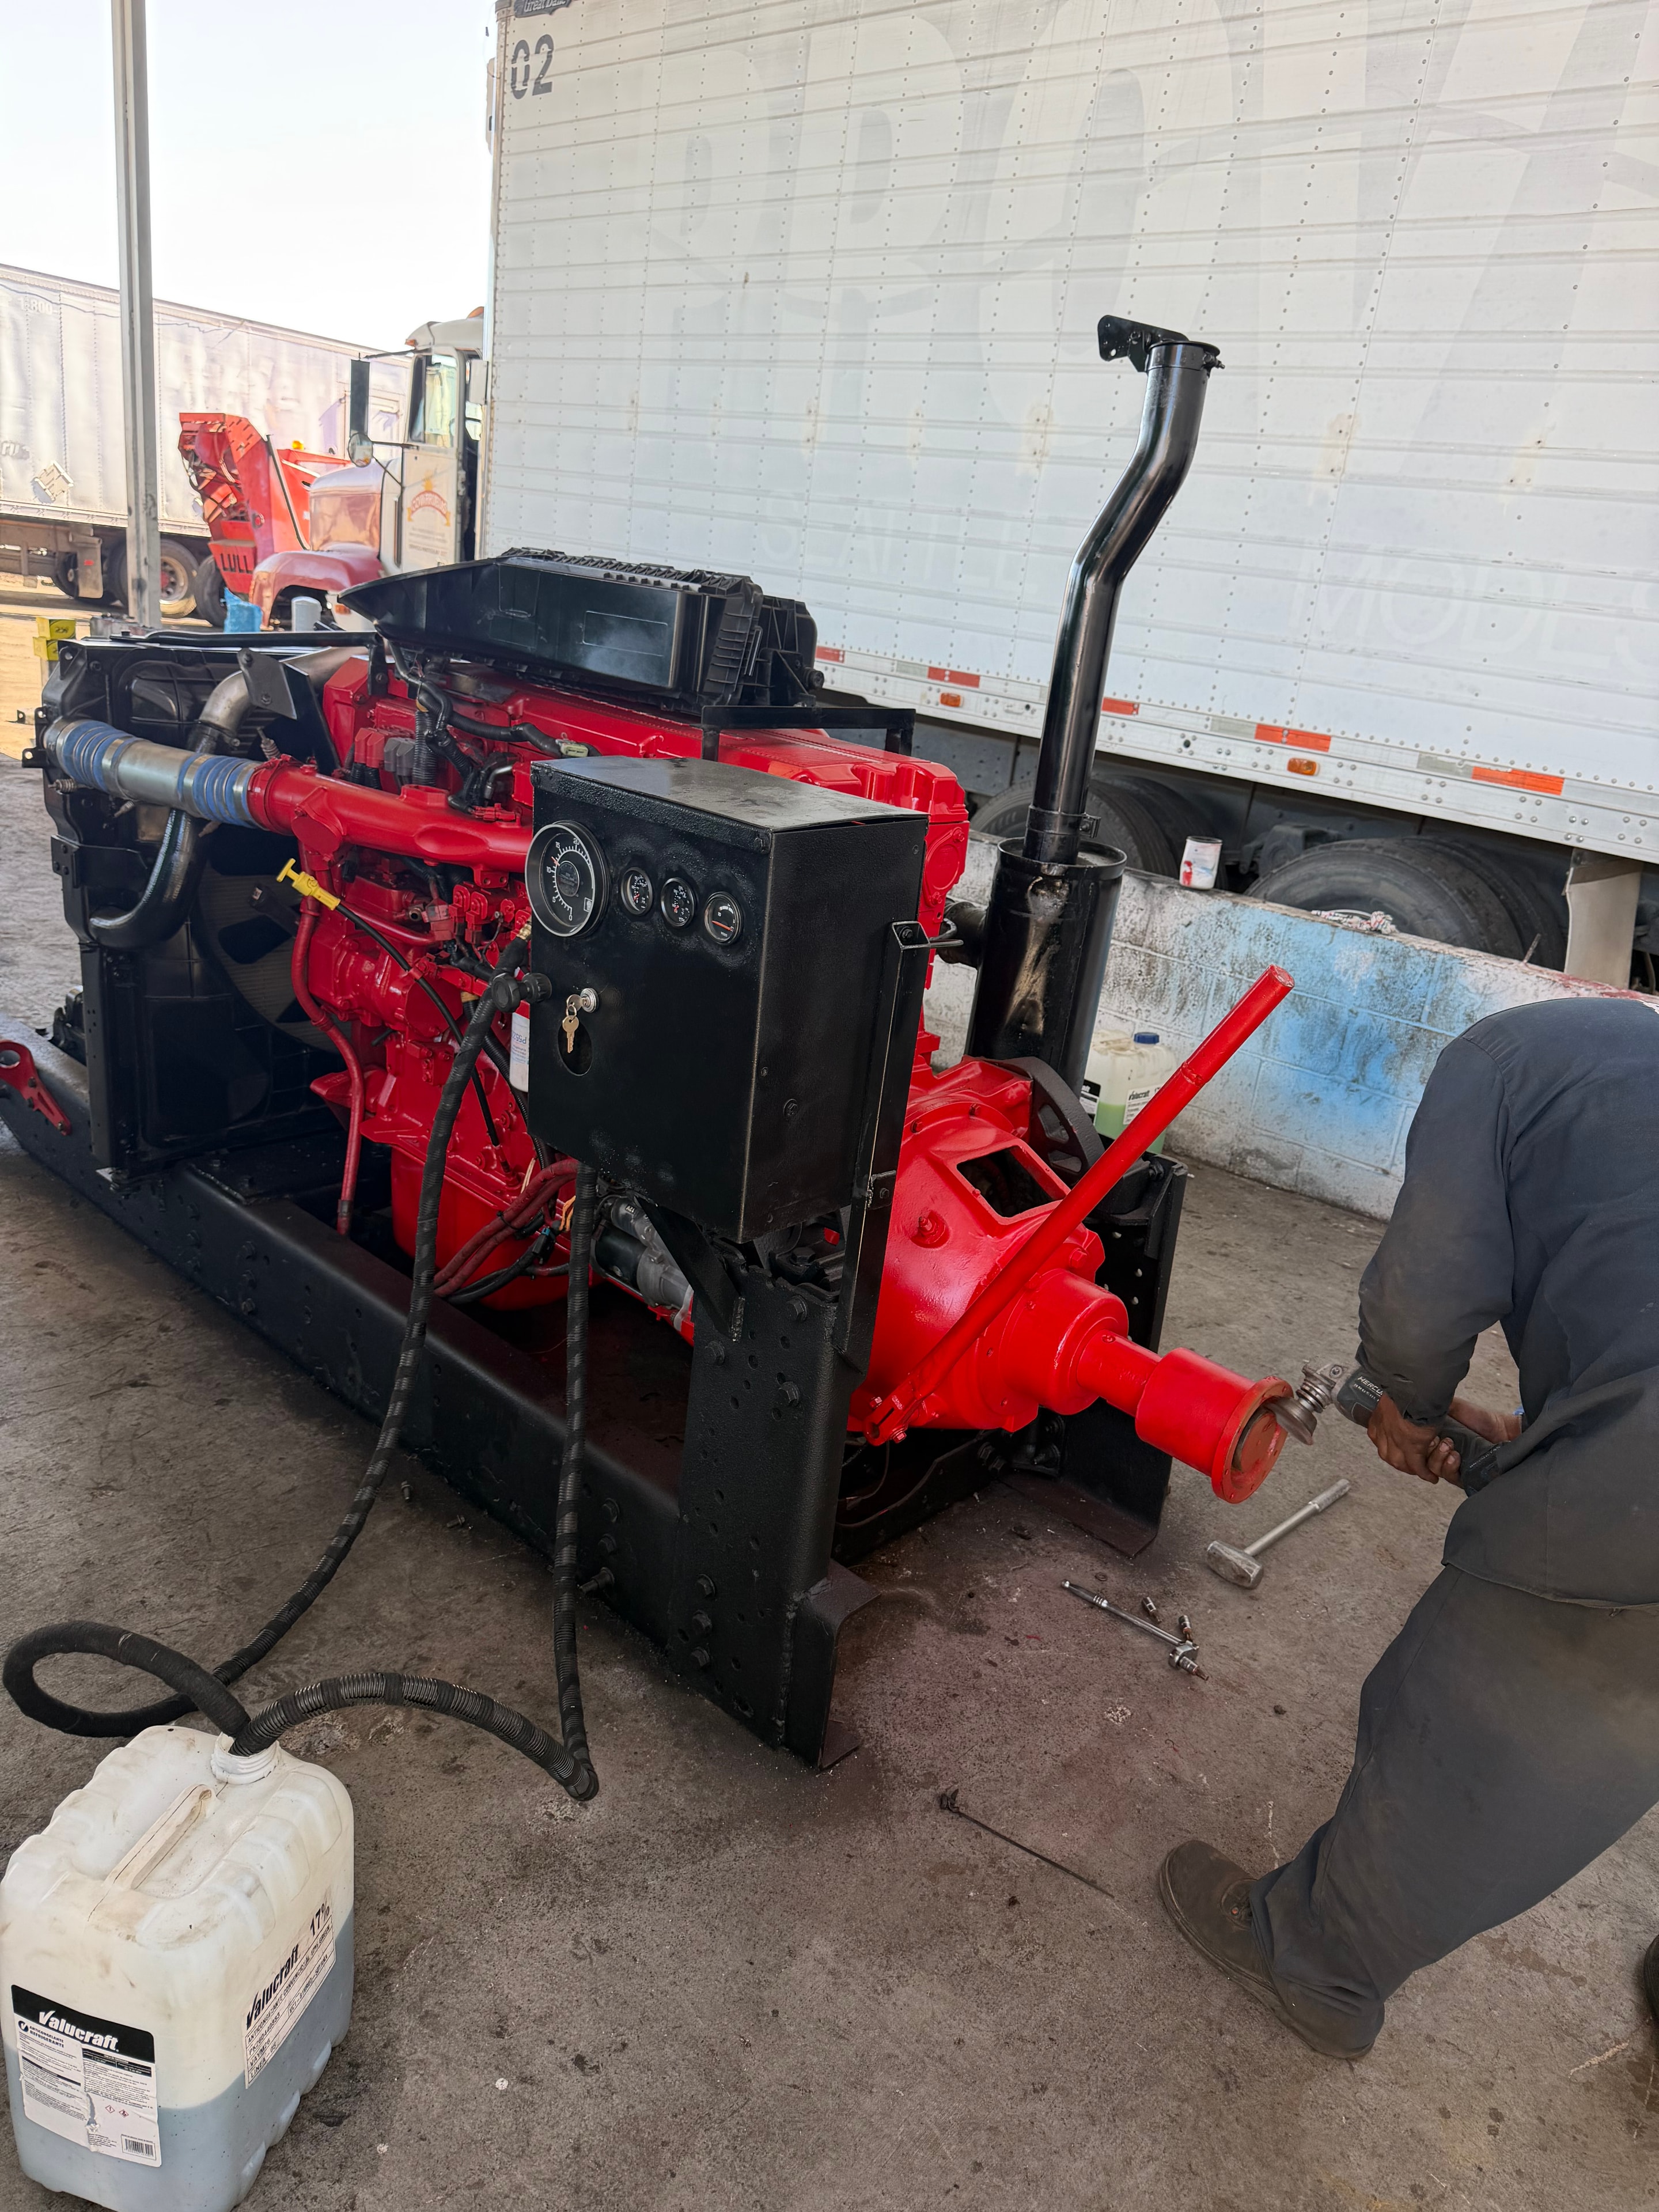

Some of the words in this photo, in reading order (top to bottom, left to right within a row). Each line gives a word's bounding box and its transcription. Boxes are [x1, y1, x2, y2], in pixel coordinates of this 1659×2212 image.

[511, 34, 554, 100] 02
[221, 554, 253, 574] LULL
[310, 1900, 330, 1936] 17%
[247, 1944, 300, 2030] Valucraft
[29, 2030, 65, 2048] REFRIGERANTE
[39, 2010, 119, 2052] Valucraft
